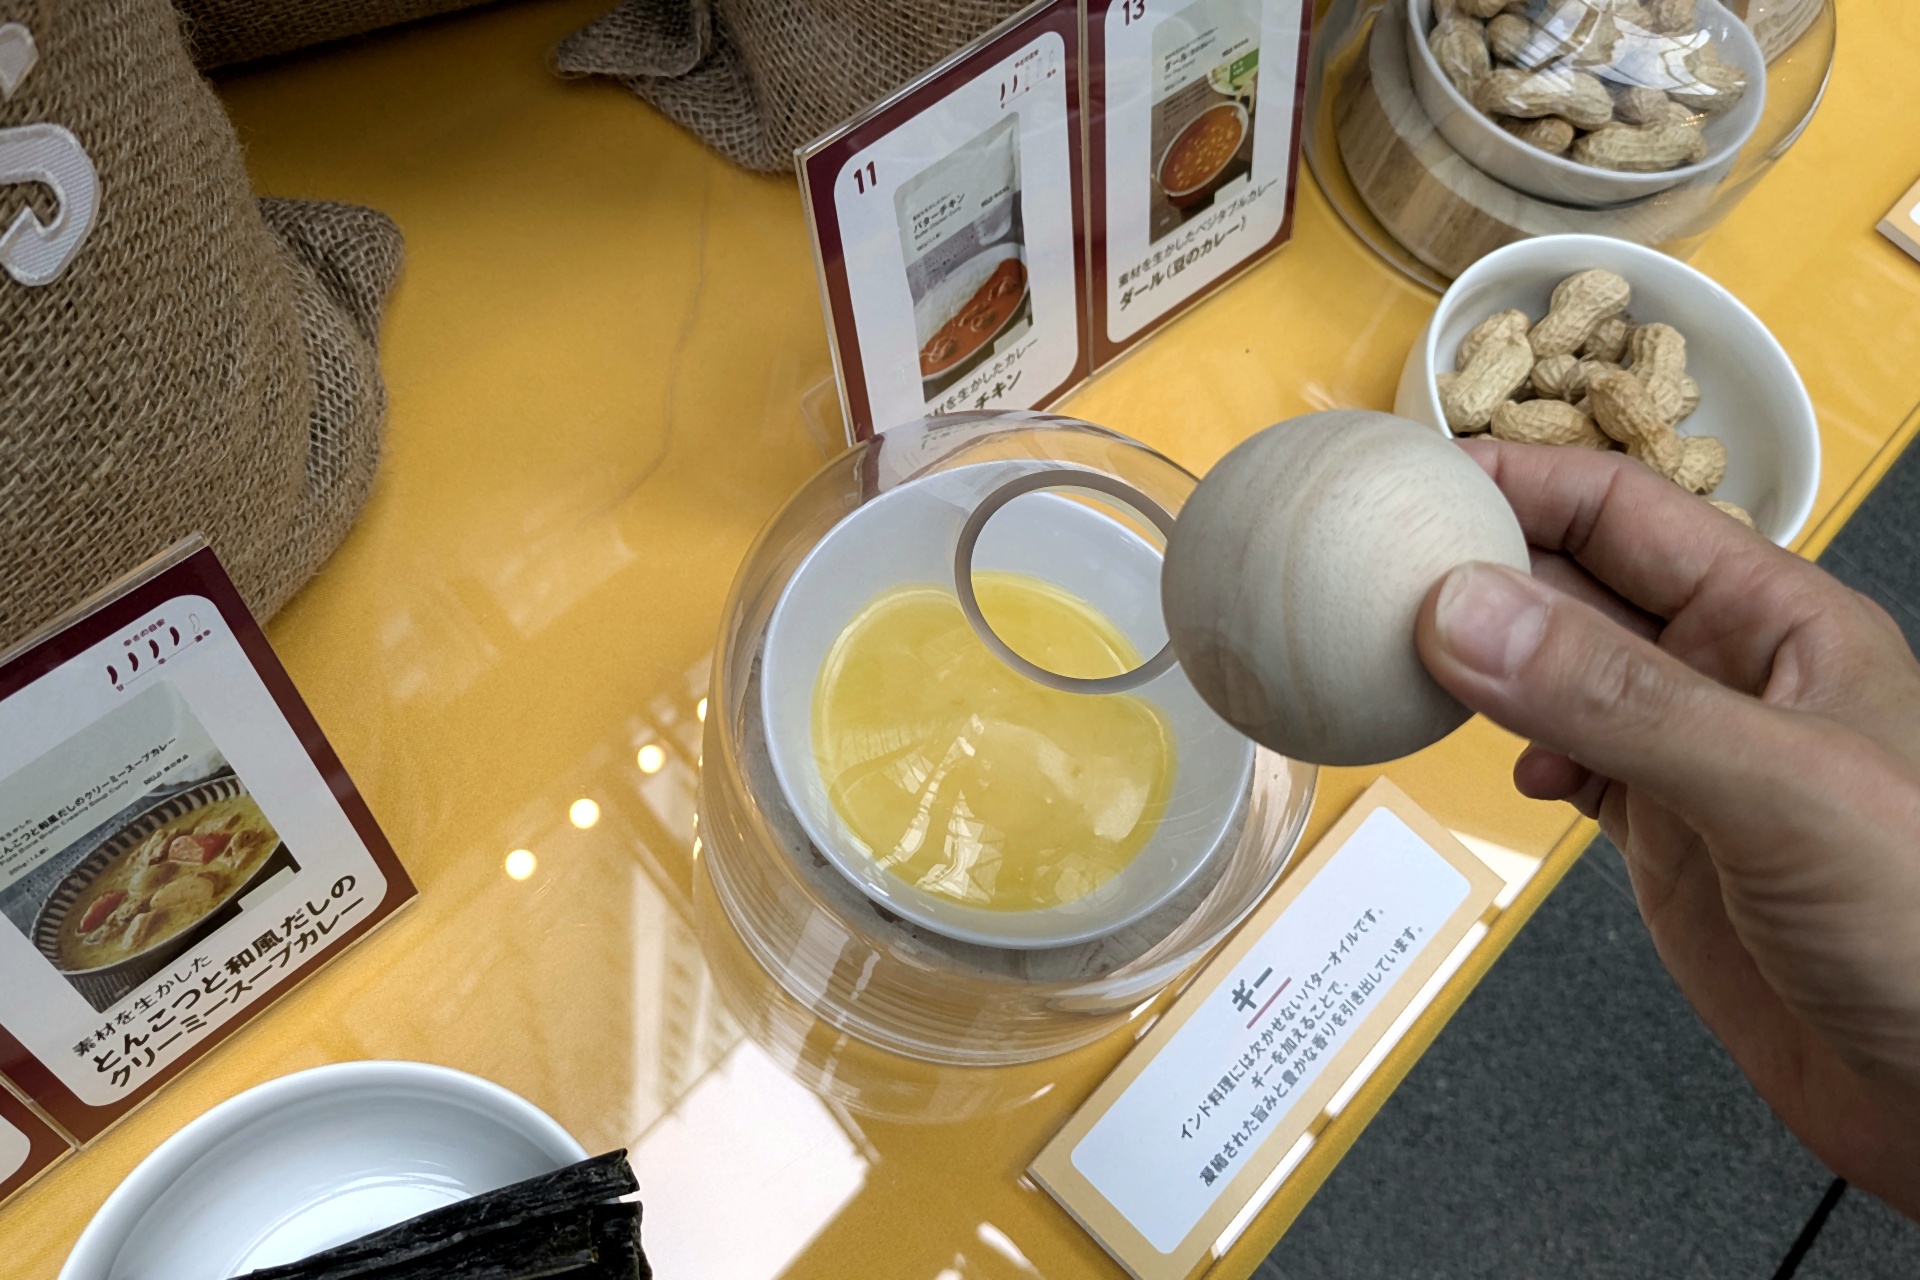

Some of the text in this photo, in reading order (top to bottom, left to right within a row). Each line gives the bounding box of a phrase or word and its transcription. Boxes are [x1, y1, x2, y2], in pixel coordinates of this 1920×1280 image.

[1122, 0, 1145, 26] 13
[853, 161, 877, 195] 11
[72, 954, 212, 1058] 素材を生かした
[93, 875, 356, 1072] とんこつと和風だしの
[111, 897, 364, 1087] クリーミースープカレー
[1181, 908, 1384, 1140] インド料理には欠かせないバターオイルです。
[1232, 966, 1273, 1012] ギー
[1250, 979, 1349, 1089] ギーを加えることで、
